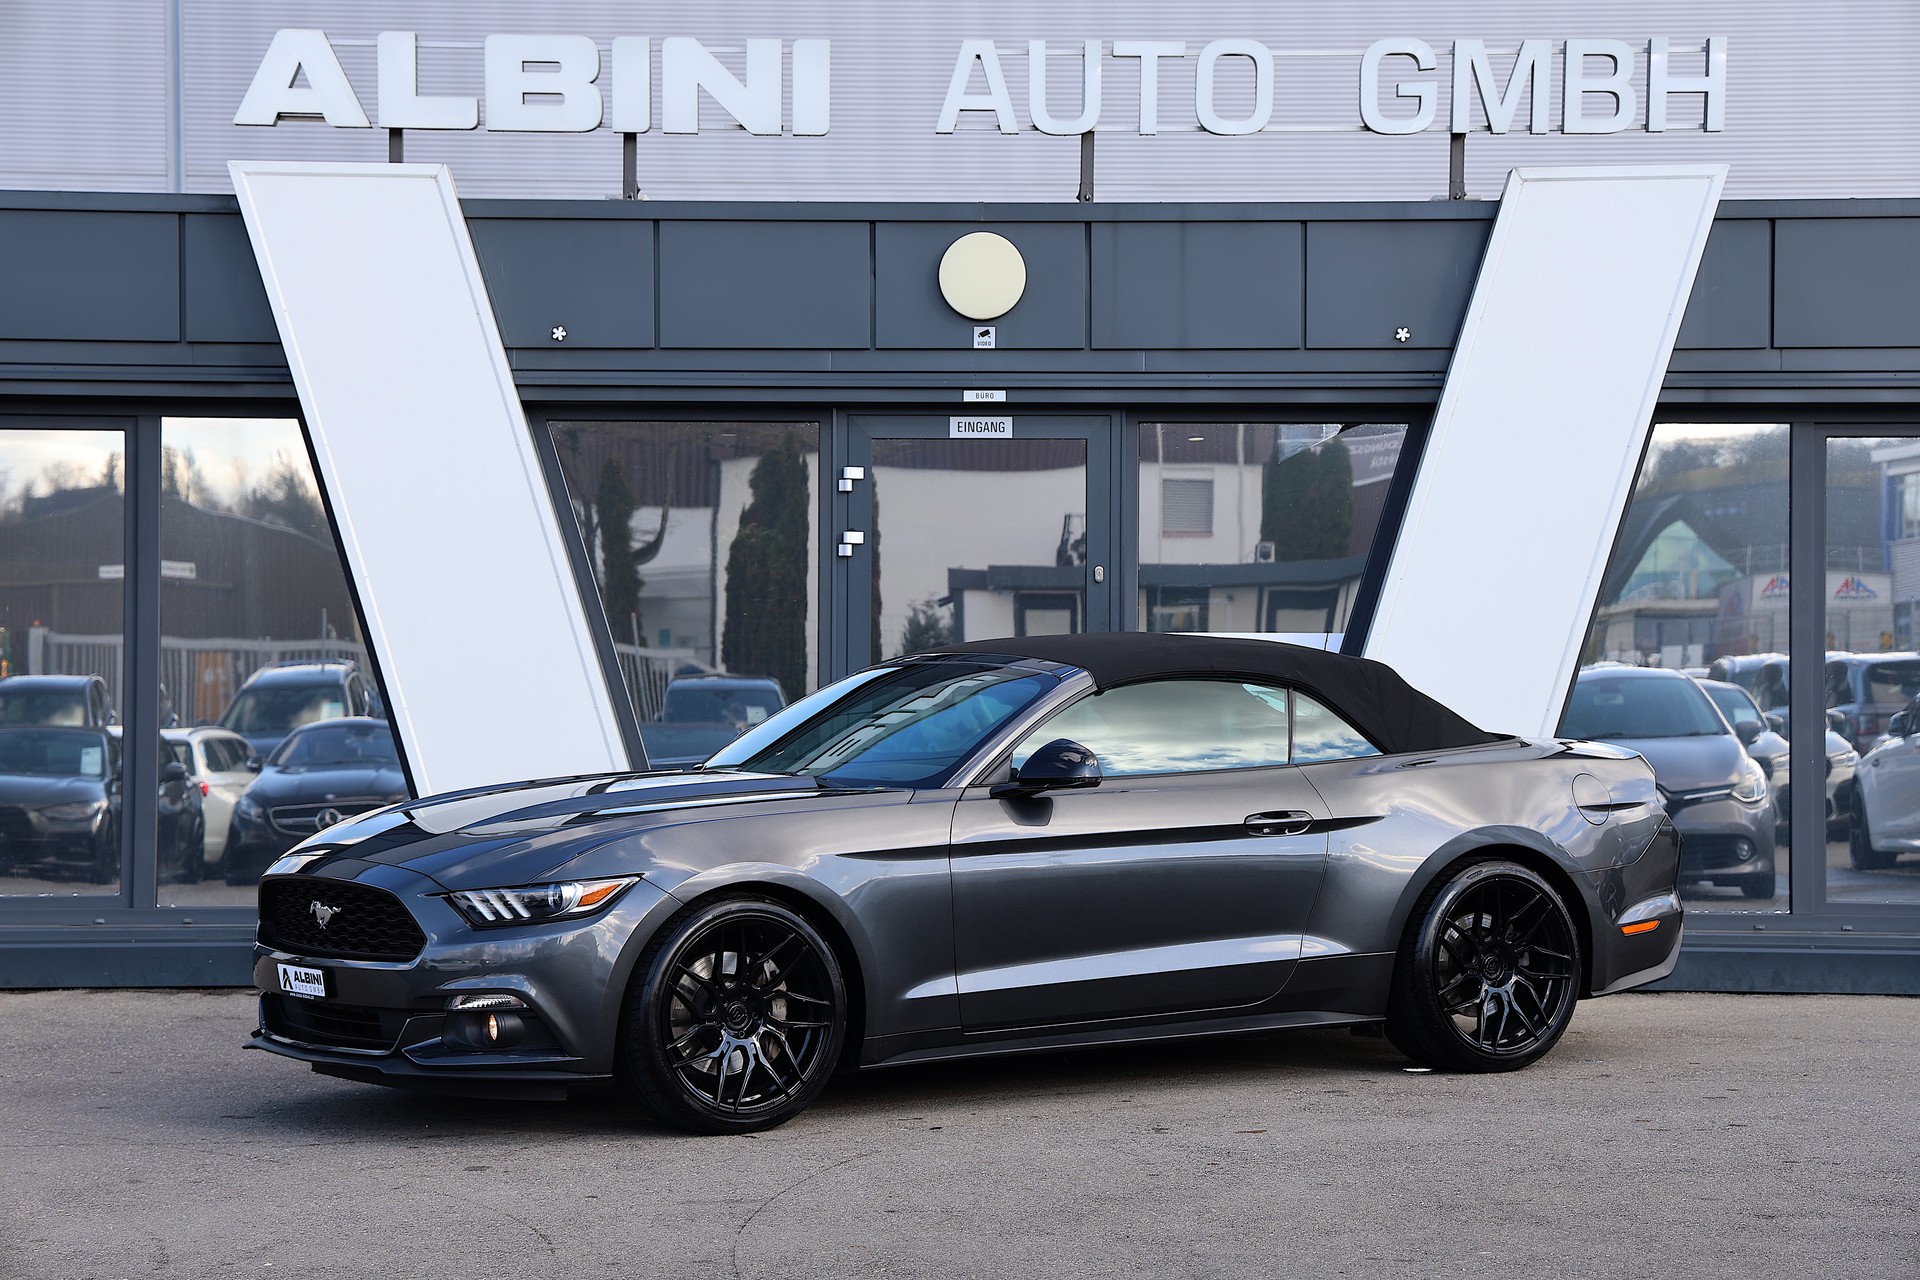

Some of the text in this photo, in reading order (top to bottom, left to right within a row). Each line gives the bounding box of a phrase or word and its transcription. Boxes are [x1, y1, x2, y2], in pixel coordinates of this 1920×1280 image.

[232, 28, 1727, 136] ALBINI AUTO GMBH
[957, 421, 1006, 433] EINGANG
[294, 970, 322, 986] ALBINI
[294, 983, 308, 992] AUTO
